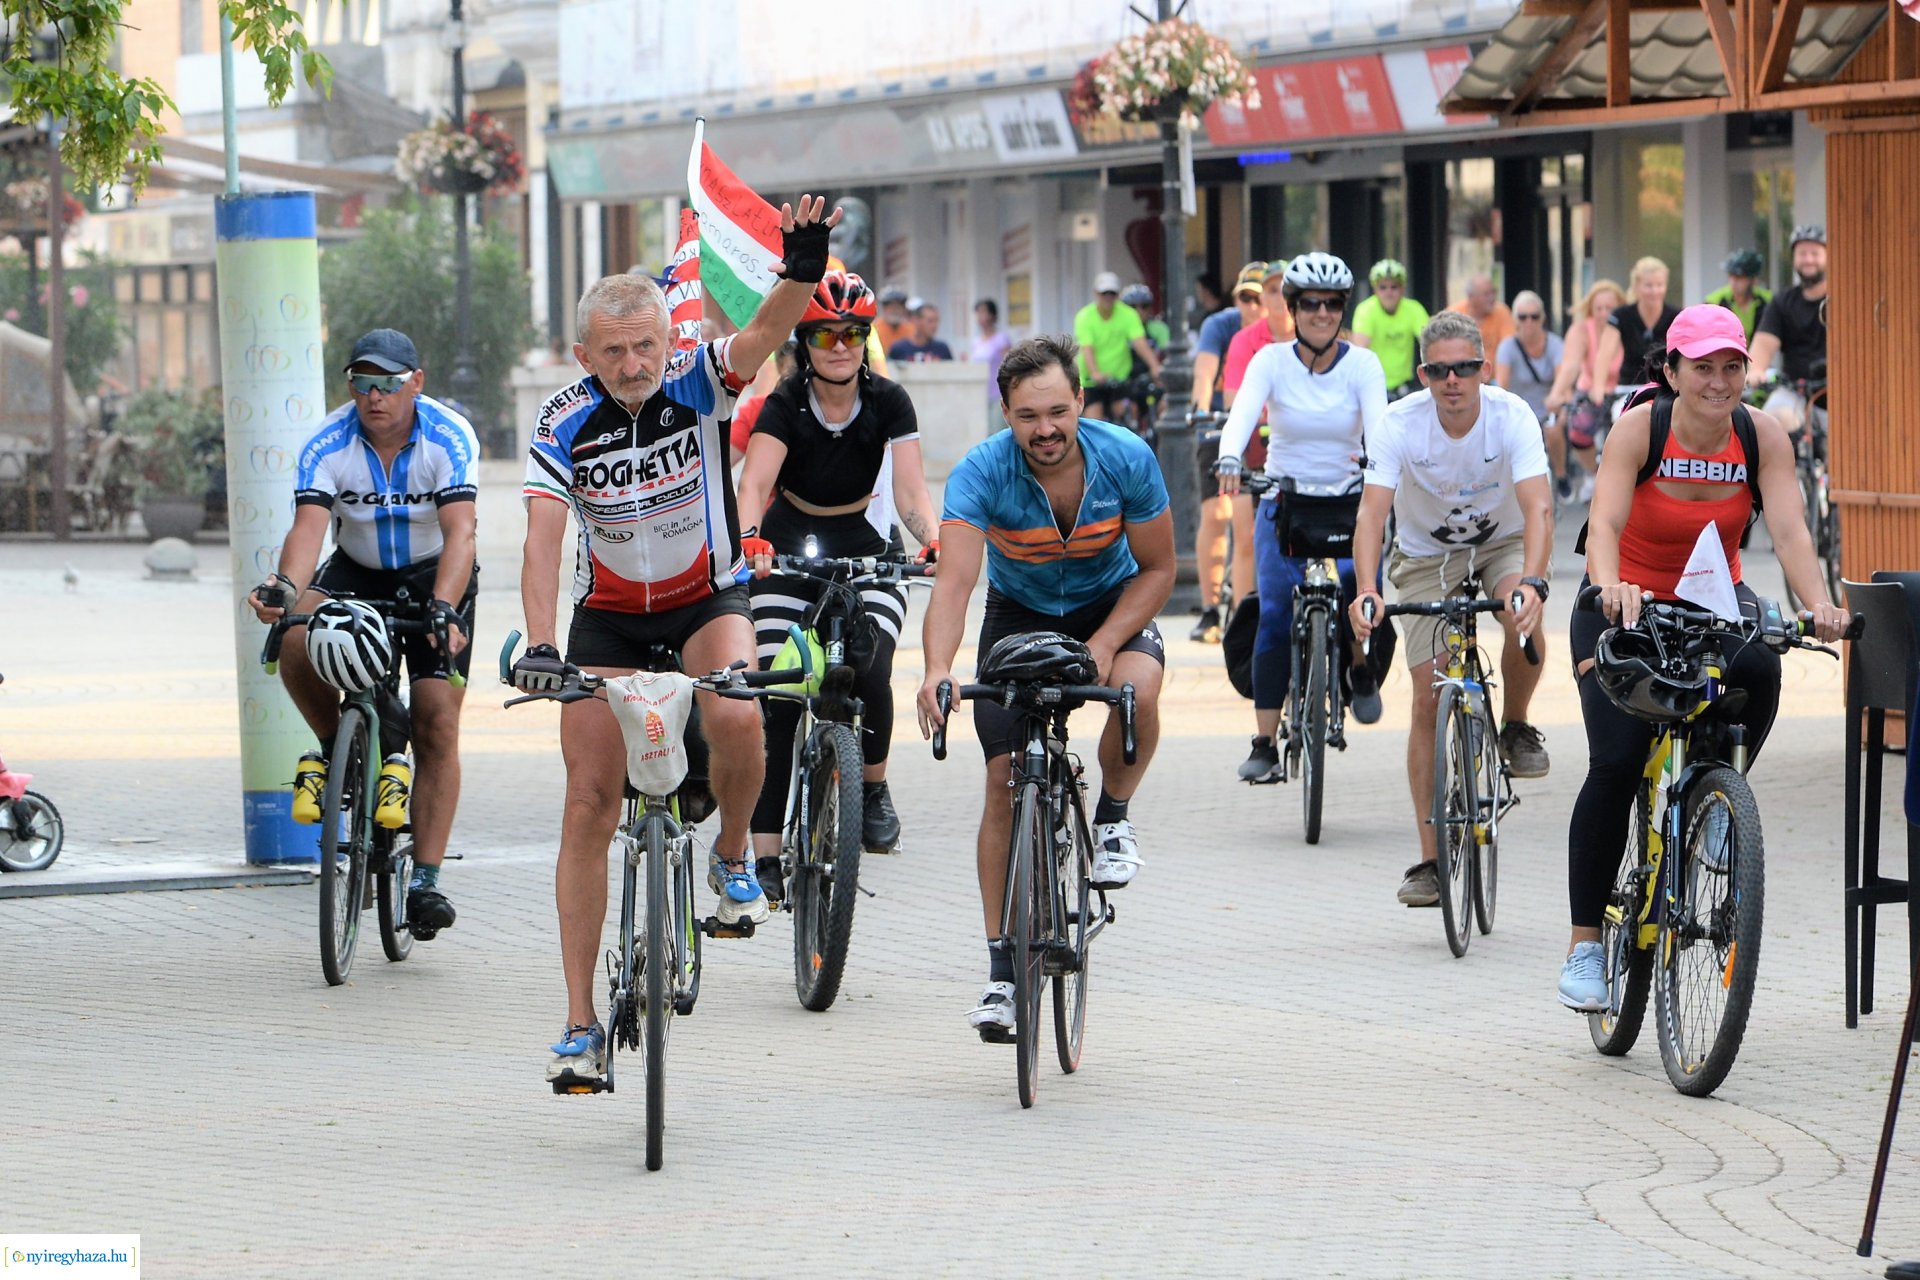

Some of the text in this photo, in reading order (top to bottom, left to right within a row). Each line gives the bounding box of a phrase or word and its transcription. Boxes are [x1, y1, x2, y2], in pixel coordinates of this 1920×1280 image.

[1660, 457, 1747, 483] NEBBIA
[361, 492, 434, 506] GIANT
[662, 517, 704, 540] ROMAGNA
